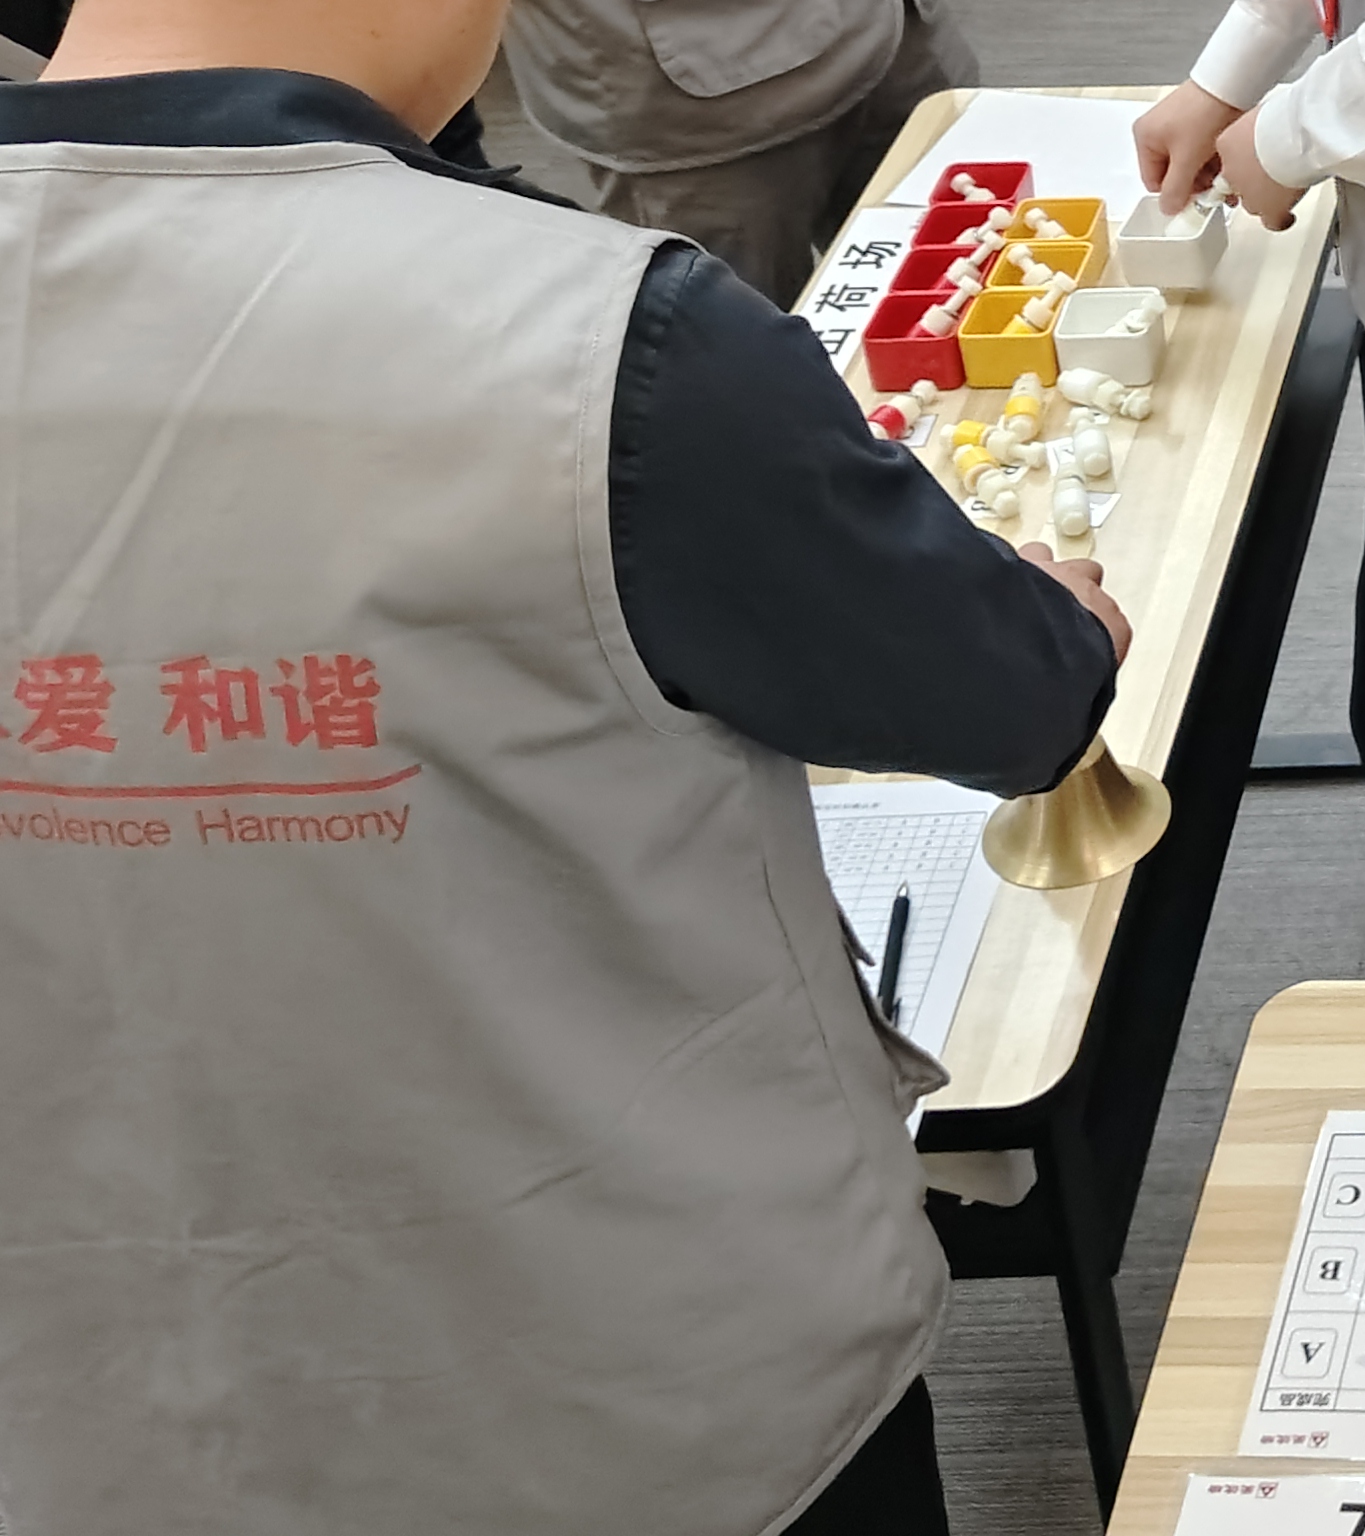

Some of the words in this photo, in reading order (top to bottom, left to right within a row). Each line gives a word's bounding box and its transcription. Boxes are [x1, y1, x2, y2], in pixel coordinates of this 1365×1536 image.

[0, 654, 118, 753] 爱
[160, 653, 382, 754] 和谐
[0, 807, 171, 847] volence
[196, 803, 411, 844] Harmony
[1334, 1183, 1363, 1207] C
[1318, 1258, 1345, 1282] B
[1300, 1340, 1328, 1365] A
[1278, 1391, 1332, 1408] 完成品
